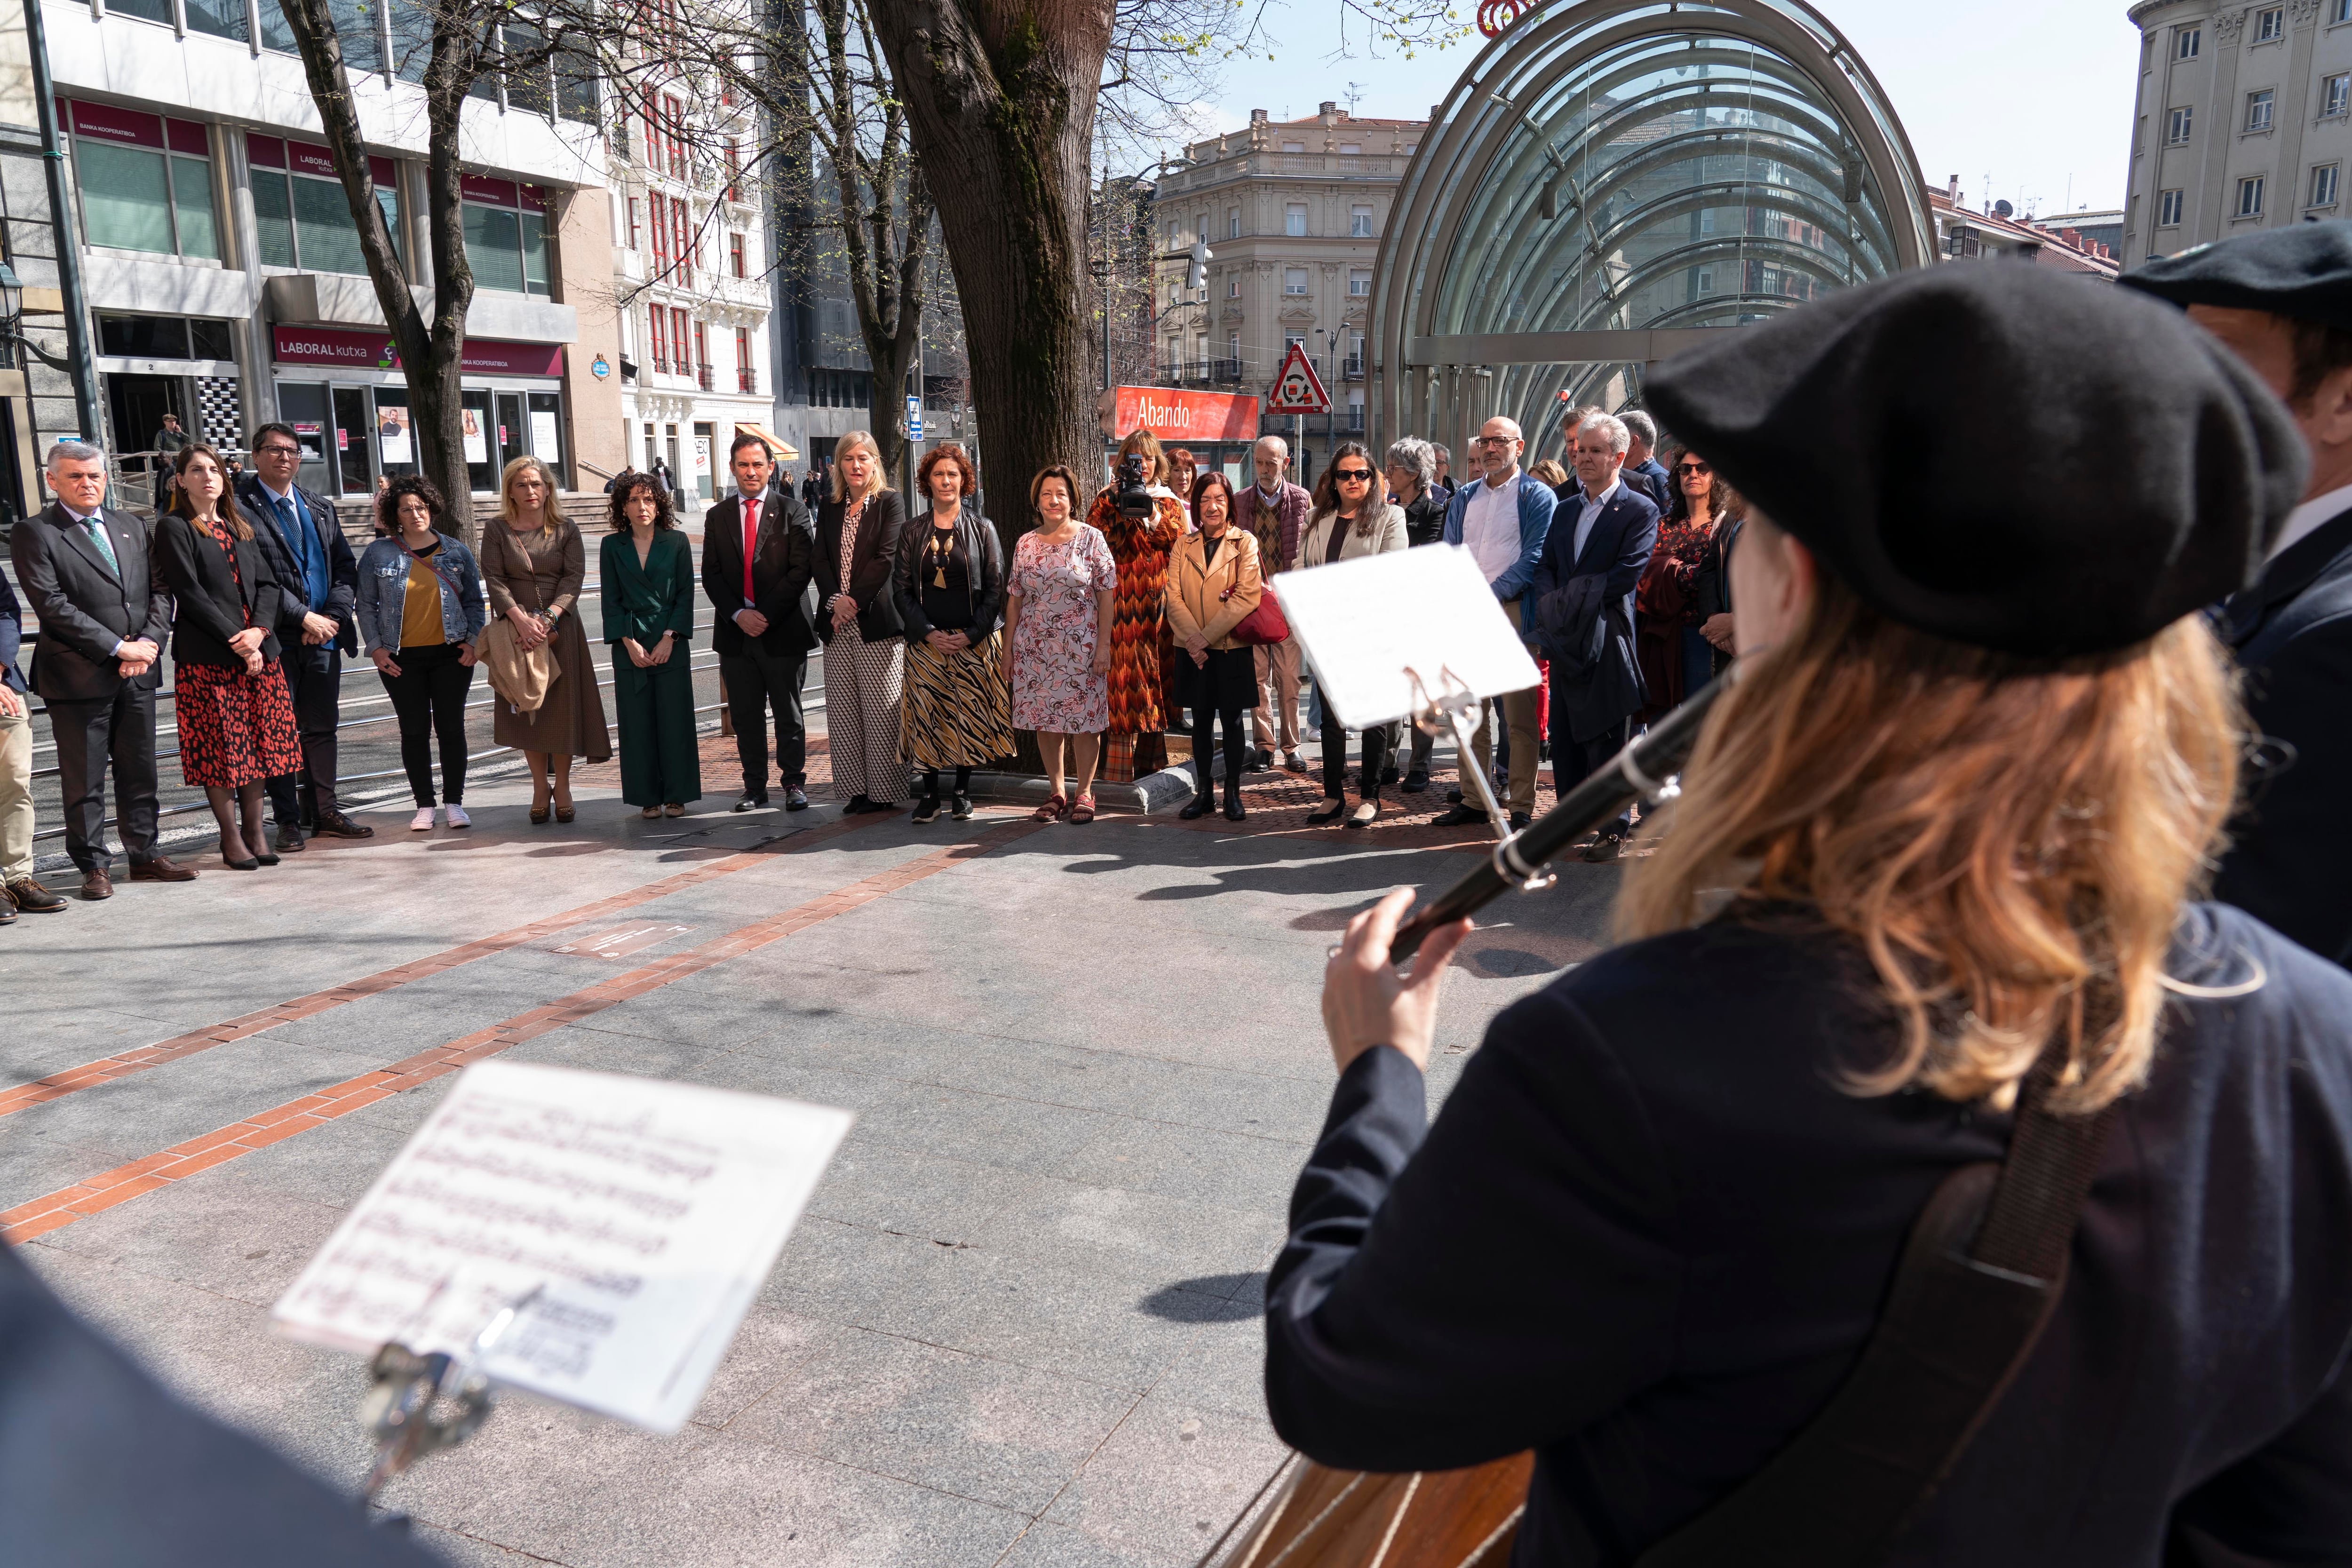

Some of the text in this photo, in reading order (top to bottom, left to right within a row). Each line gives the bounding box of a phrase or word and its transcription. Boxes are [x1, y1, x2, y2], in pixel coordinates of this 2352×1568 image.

[98, 126, 136, 137] KOOPERATIBOA
[300, 155, 332, 167] LABORAL
[280, 342, 367, 357] LABORAL kutxa
[1136, 396, 1190, 428] Abando
